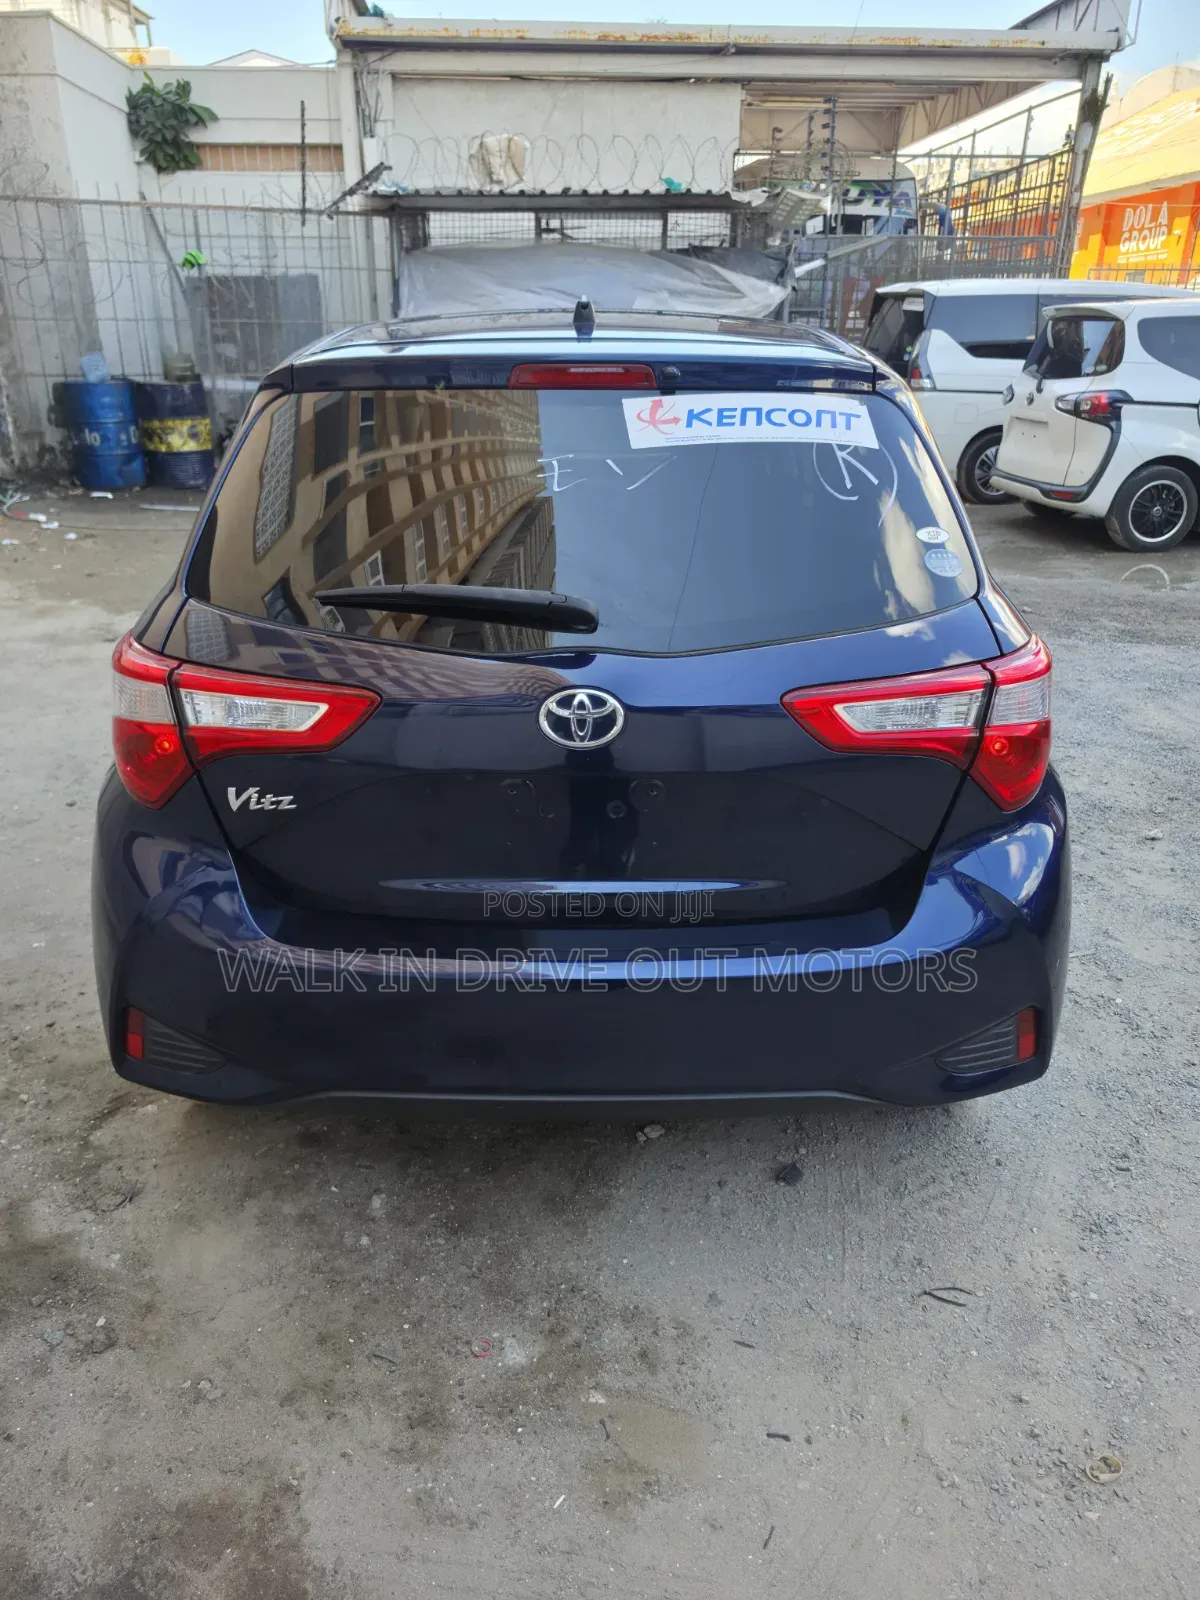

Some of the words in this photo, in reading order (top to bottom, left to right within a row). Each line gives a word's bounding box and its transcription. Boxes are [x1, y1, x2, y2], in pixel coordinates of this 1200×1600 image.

[1122, 201, 1169, 232] DOLA
[1119, 226, 1169, 253] GROUP
[227, 786, 298, 812] Vitz
